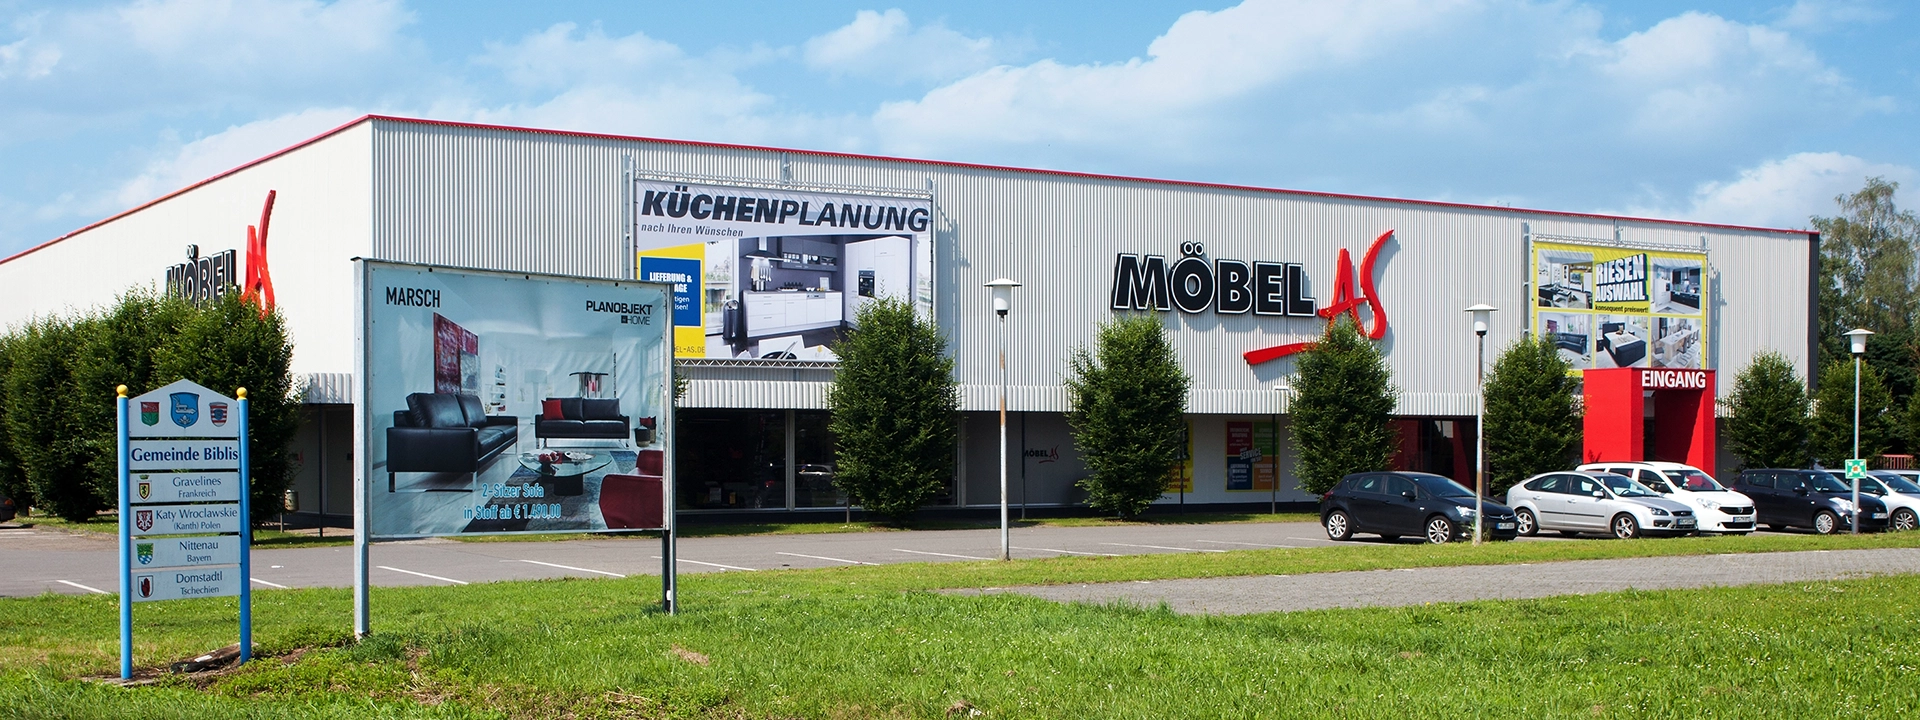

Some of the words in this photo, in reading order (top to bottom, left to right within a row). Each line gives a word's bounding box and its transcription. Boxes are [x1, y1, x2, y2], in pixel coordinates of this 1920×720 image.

[641, 185, 929, 232] KÜCHENPLANUNG
[641, 223, 665, 233] nach
[667, 224, 692, 235] Ihren
[696, 225, 744, 238] Wünschen
[1595, 253, 1645, 285] RIESEN
[649, 272, 686, 283] LIEFERUNG
[686, 274, 693, 283] &
[1111, 240, 1316, 317] MÖBEL
[1318, 229, 1395, 340] AS
[386, 286, 441, 308] MARSCH
[1595, 280, 1646, 302] AUSWAHL
[586, 300, 652, 316] PLANOBJEKT
[1595, 304, 1624, 312] konsequent
[627, 314, 651, 325] HOME
[674, 345, 705, 354] EL-AS.DE
[1641, 370, 1706, 389] EINGANG
[131, 446, 200, 462] Gemeinde
[203, 446, 239, 461] Biblis
[1240, 447, 1262, 460] SERVICE
[172, 475, 222, 487] Gravelines
[178, 489, 217, 498] Frankreich
[482, 483, 521, 498] 2-Sitzer
[522, 482, 545, 498] Sofa
[156, 509, 177, 522] Katy
[179, 507, 238, 519] Wroclawskie
[463, 505, 473, 519] in
[475, 504, 499, 520] Stoff
[499, 504, 512, 519] ab
[513, 504, 521, 519] €
[522, 503, 562, 520] 1.490,00
[173, 521, 200, 531] (Kanth)
[200, 521, 221, 530] Polen
[179, 541, 219, 551] Nittenau
[186, 554, 212, 564] Bayern
[176, 571, 223, 583] Domstadtl
[181, 585, 219, 595] Tschechien
